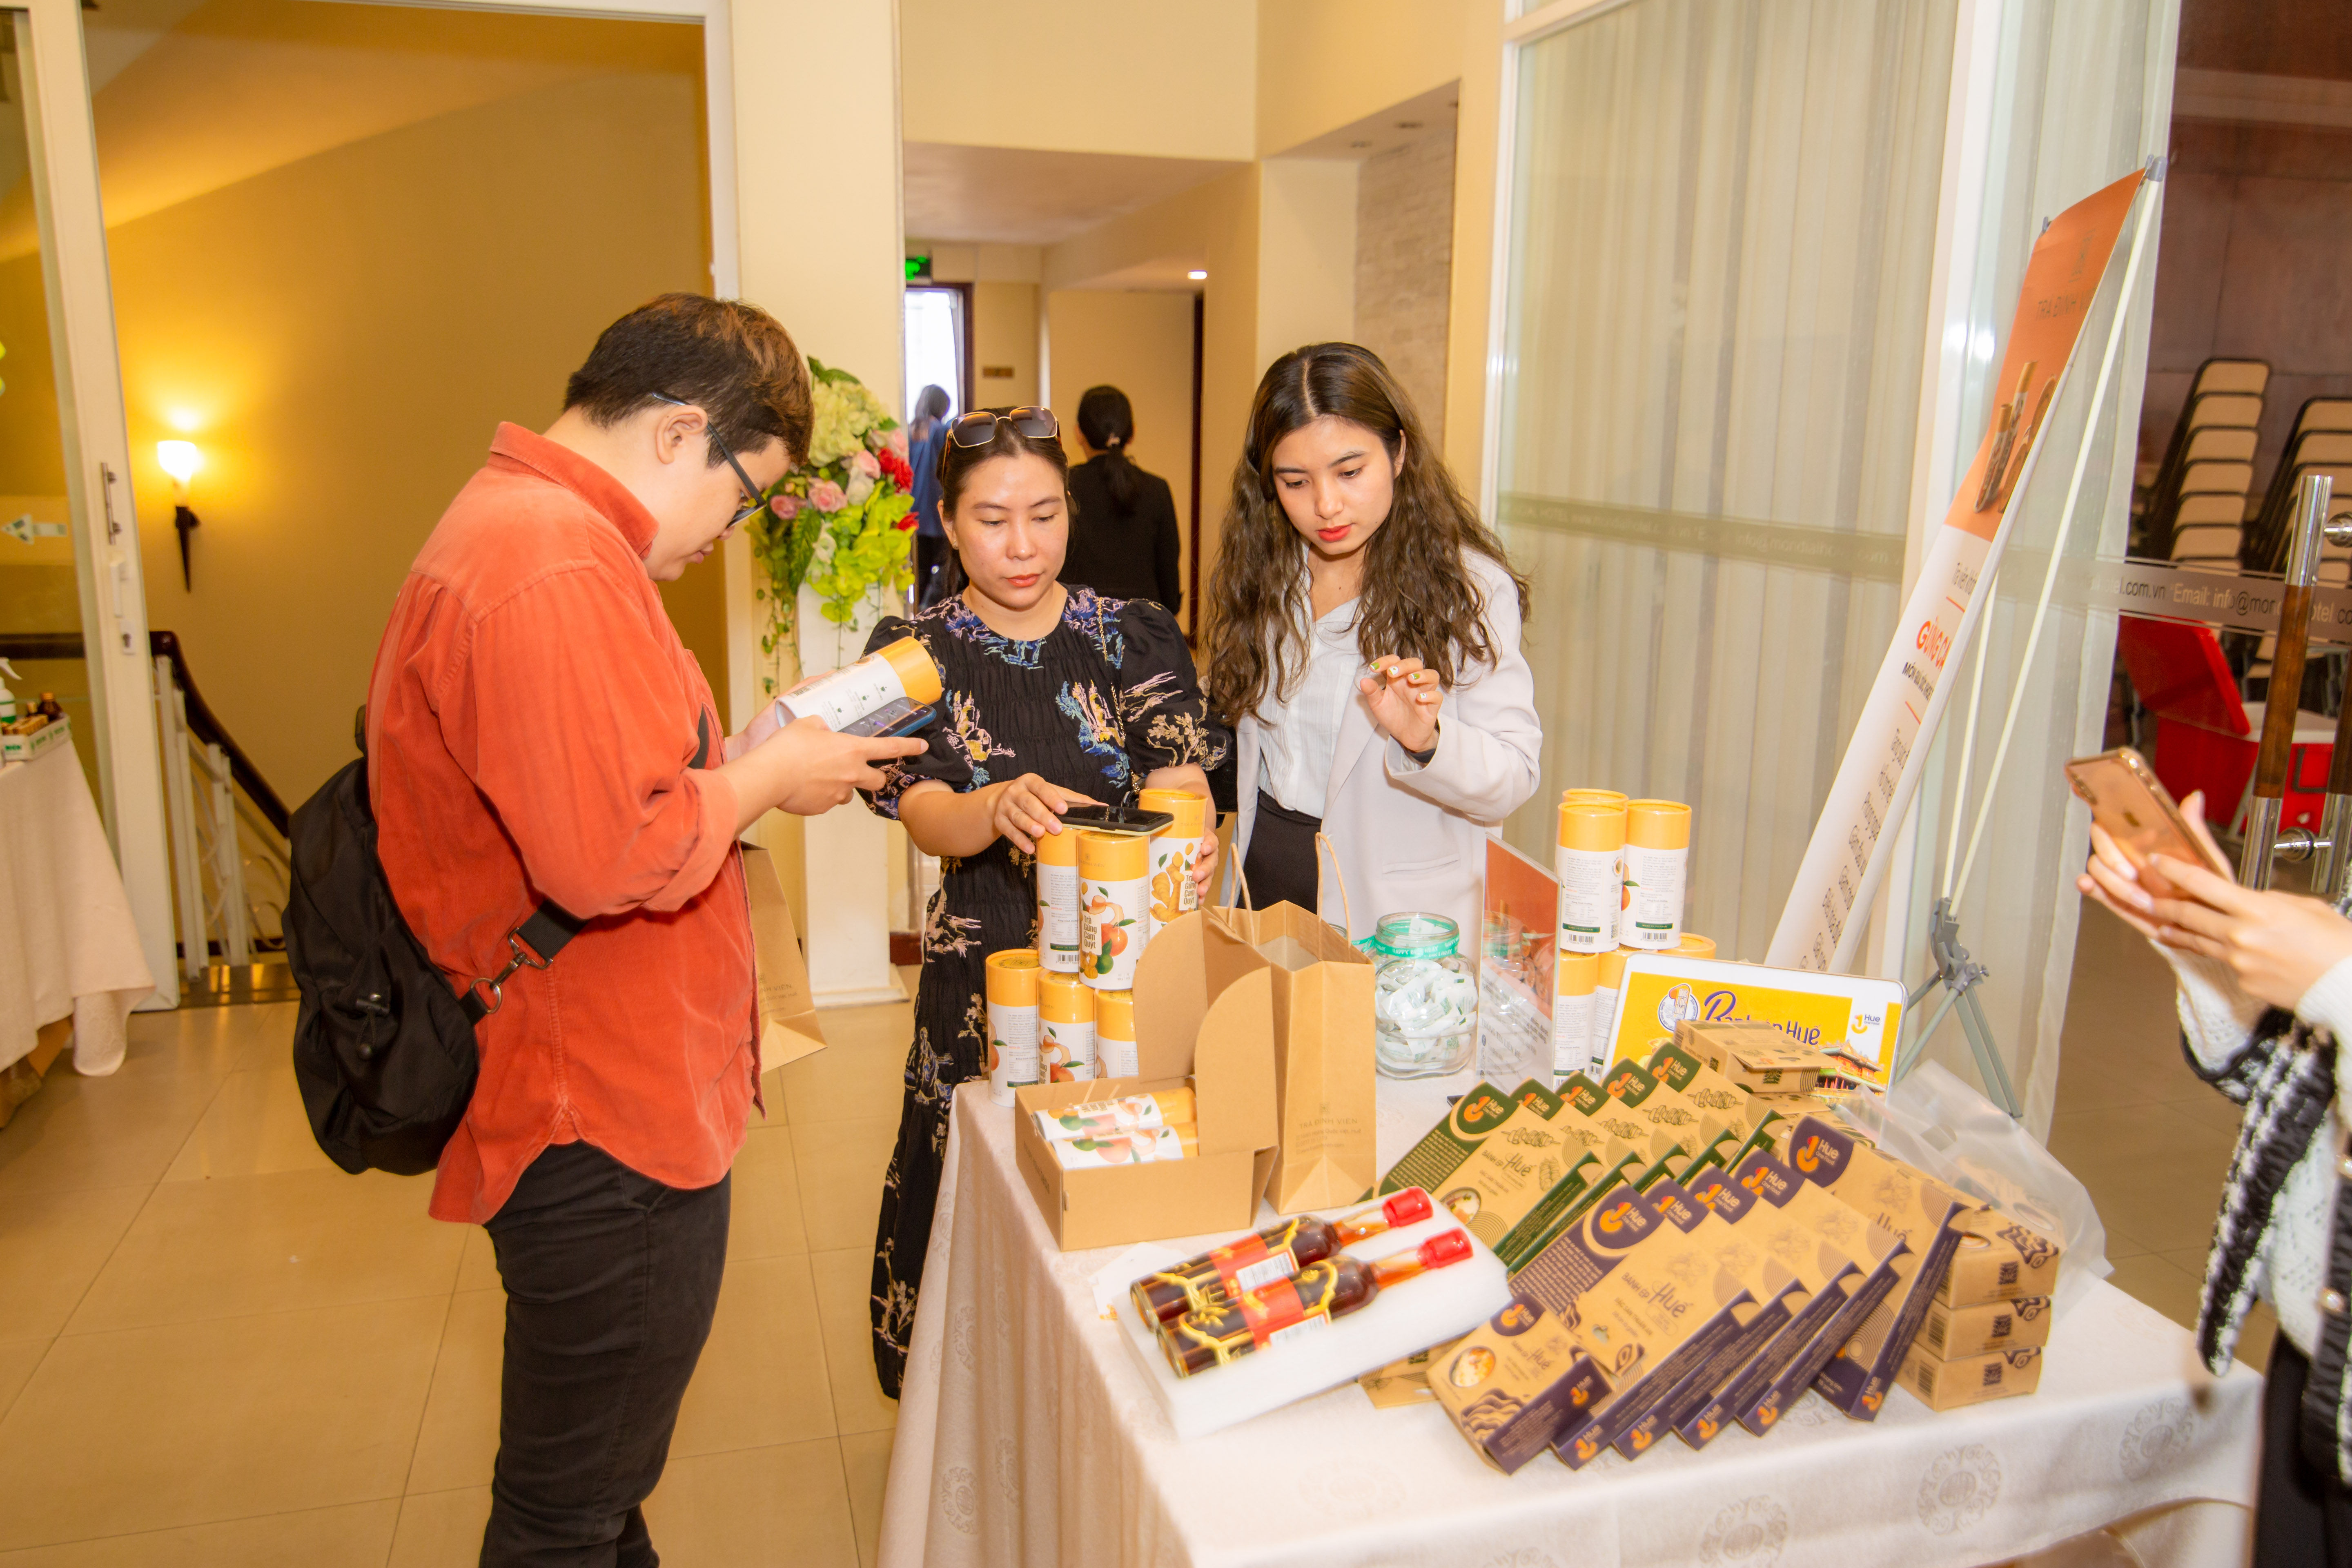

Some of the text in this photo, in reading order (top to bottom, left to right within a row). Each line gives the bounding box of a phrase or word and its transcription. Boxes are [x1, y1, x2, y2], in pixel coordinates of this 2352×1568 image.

[1935, 635, 1951, 673] CA
[1184, 897, 1194, 905] Quýt
[1084, 915, 1092, 924] Trà
[1084, 922, 1097, 933] Gừng
[1084, 931, 1095, 940] Cam
[1084, 939, 1096, 949] Quýt
[1864, 1014, 1881, 1022] Hue
[1786, 1020, 1821, 1046] Huế
[1671, 1060, 1687, 1076] Hue
[1628, 1076, 1645, 1091] Hue
[1532, 1096, 1550, 1112] Hue
[1579, 1089, 1596, 1105] Hue
[1486, 1098, 1505, 1115] Hue
[1817, 1139, 1840, 1160] Hue
[1501, 1152, 1537, 1177] Huế
[1765, 1170, 1788, 1190] Hue
[1718, 1187, 1741, 1207] Hue
[1626, 1206, 1647, 1227] Hue
[1670, 1200, 1692, 1220] Hue
[1621, 1271, 1694, 1318] BÁNH ÉP Huế
[1520, 1308, 1535, 1323] Hue
[1577, 1375, 1593, 1389] Hue
[1764, 1390, 1781, 1408] Hue
[1705, 1403, 1722, 1421] Hue
[1639, 1413, 1656, 1432] Hue
[1582, 1423, 1603, 1441] Hue
